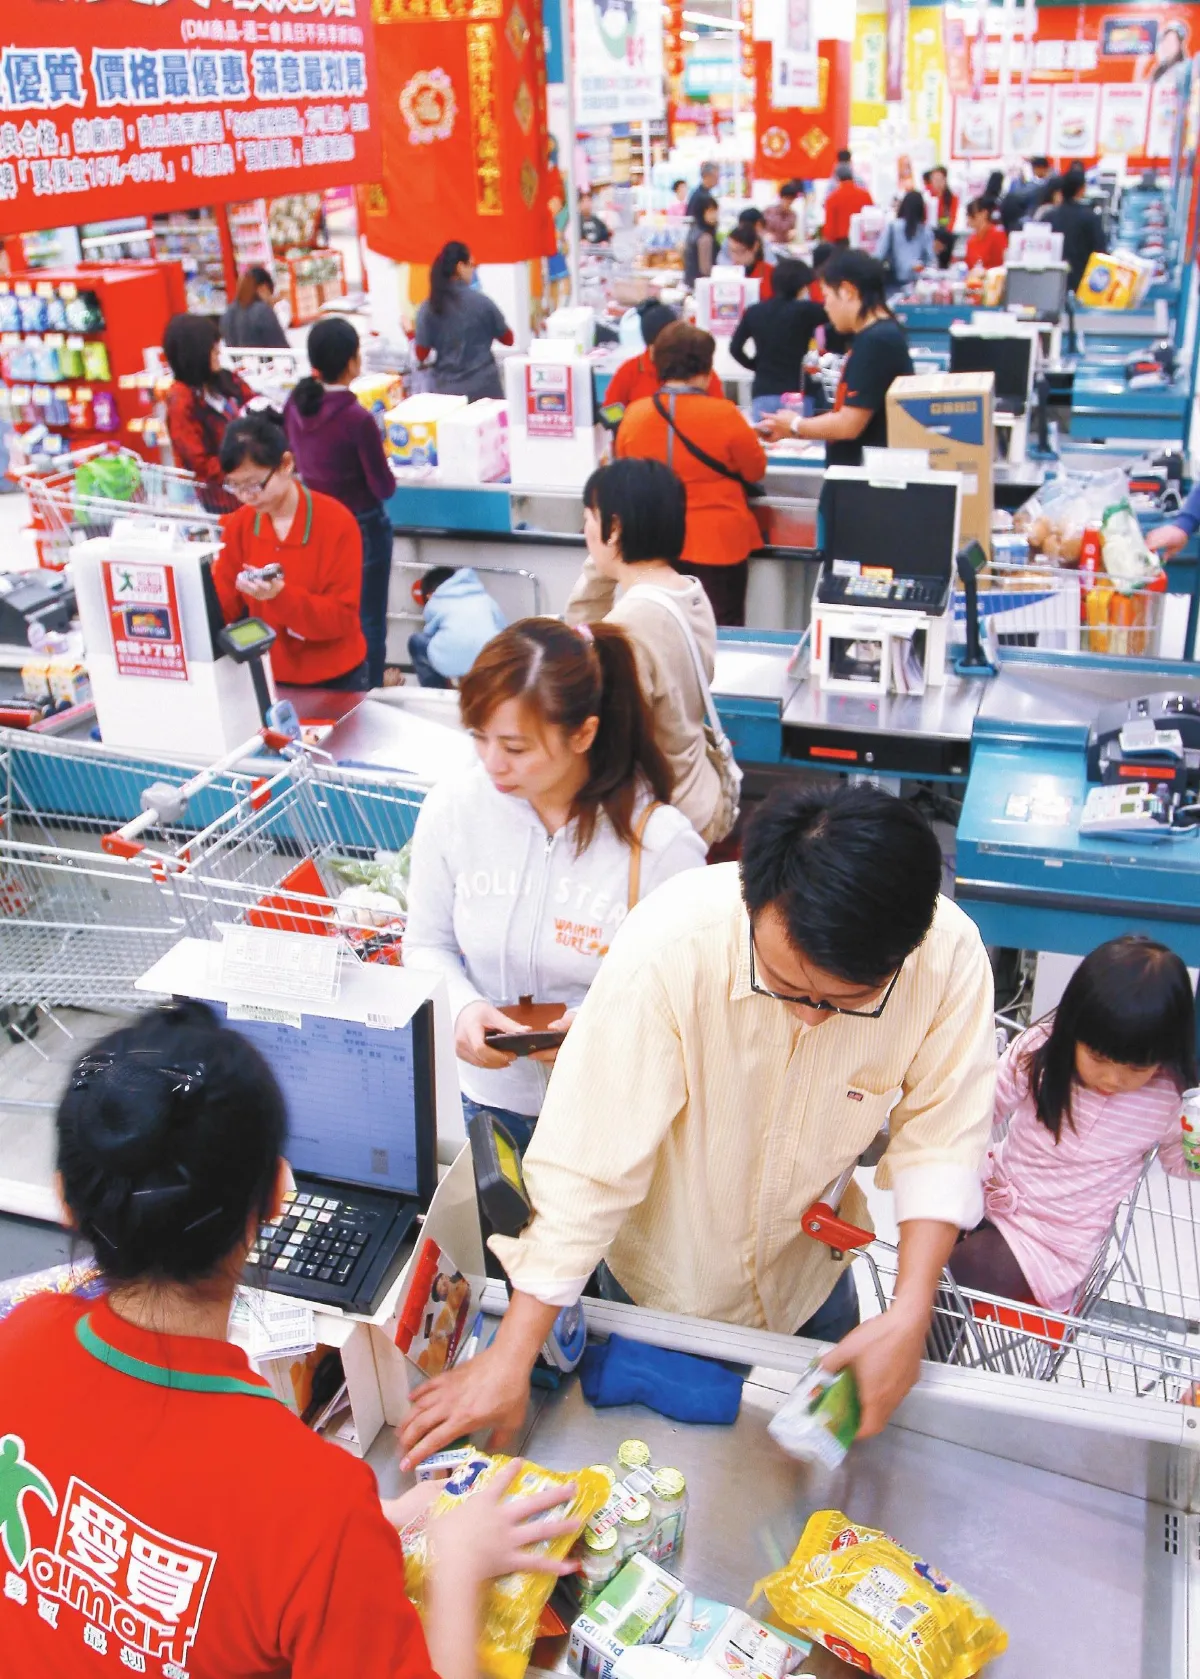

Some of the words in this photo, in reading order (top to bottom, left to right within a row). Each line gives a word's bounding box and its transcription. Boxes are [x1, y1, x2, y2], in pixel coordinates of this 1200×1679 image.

[92, 48, 249, 105] 價格最優惠
[253, 50, 367, 100] 滿意最划算
[555, 917, 603, 939] WAIKIKI
[556, 932, 586, 952] SURF
[67, 1494, 203, 1624] 愛買
